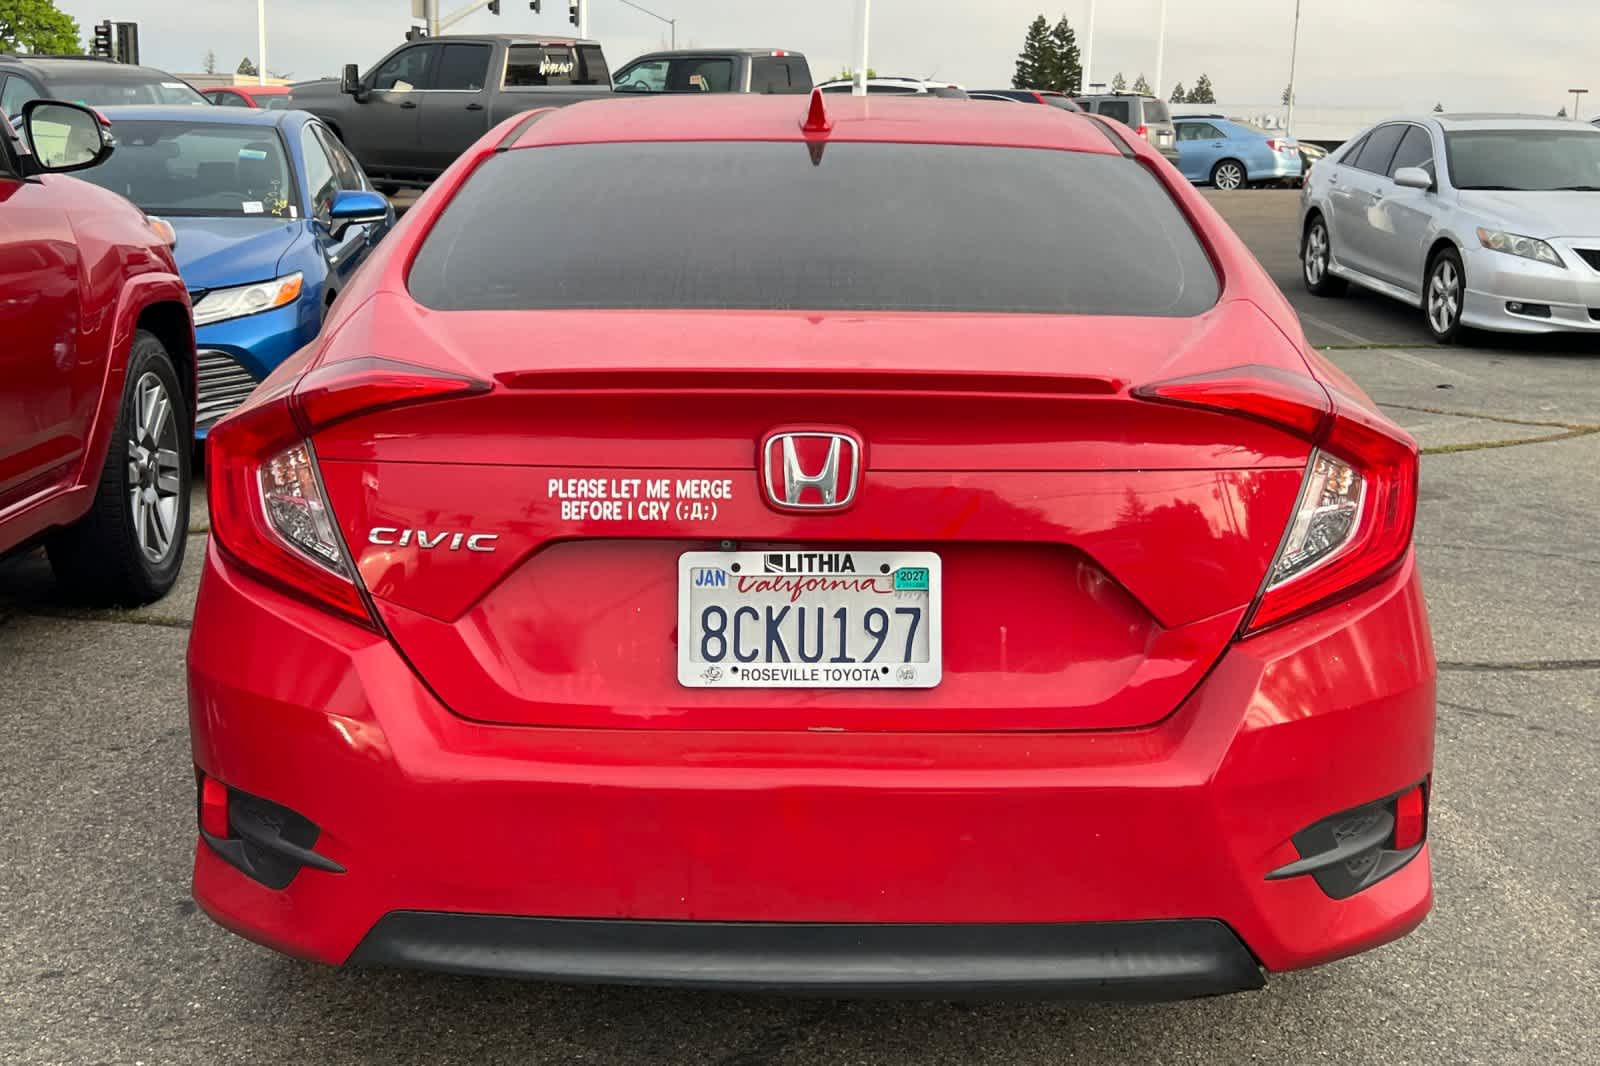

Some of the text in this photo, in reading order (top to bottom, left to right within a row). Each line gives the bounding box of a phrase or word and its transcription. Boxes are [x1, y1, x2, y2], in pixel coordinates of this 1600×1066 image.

[548, 479, 732, 499] PLEASE LET ME MERGE
[561, 501, 623, 521] BEFORE
[627, 501, 633, 520] I
[638, 501, 670, 521] CRY
[368, 527, 499, 551] CIVIC
[785, 553, 856, 573] LITHIA
[695, 569, 726, 587] JAN
[900, 571, 925, 581] 2027
[737, 575, 893, 602] California
[701, 605, 921, 664] 8CKU197
[741, 668, 880, 681] ROSEVILLE TOYOTA
